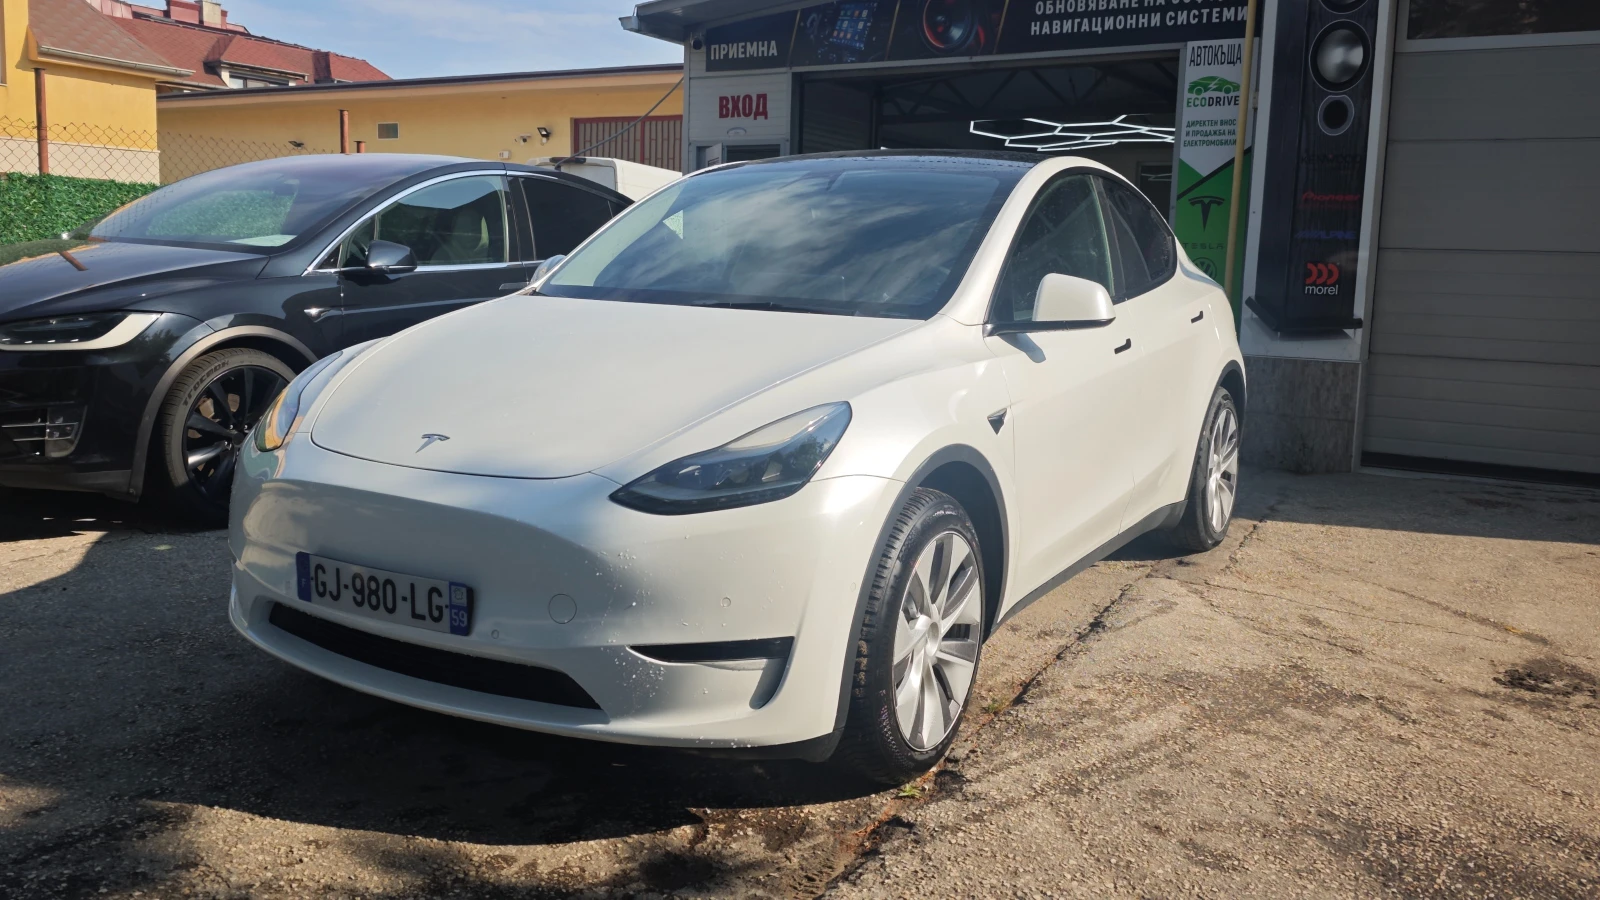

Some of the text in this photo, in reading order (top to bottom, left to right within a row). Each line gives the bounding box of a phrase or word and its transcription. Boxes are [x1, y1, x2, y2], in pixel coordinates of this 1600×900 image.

[1030, 5, 1248, 36] НАВИГАЦИОННИ СИСТЕМИ
[710, 40, 778, 60] ПРИЕМНА
[1188, 43, 1242, 67] АВТОКЪЩА
[718, 93, 768, 120] ВХОД
[1186, 95, 1240, 108] ECODRIVE
[1186, 119, 1237, 128] ДИРЕКТЕН ВНОС
[1191, 129, 1226, 137] ПРОДАЖБА
[1183, 138, 1237, 147] ЕЛЕКТРОМОБИЛИ
[1302, 190, 1360, 202] Pioneer
[1182, 242, 1224, 250] TESLA
[1304, 284, 1339, 296] morel
[314, 563, 444, 624] GJ-980-LG
[451, 609, 467, 628] 59
